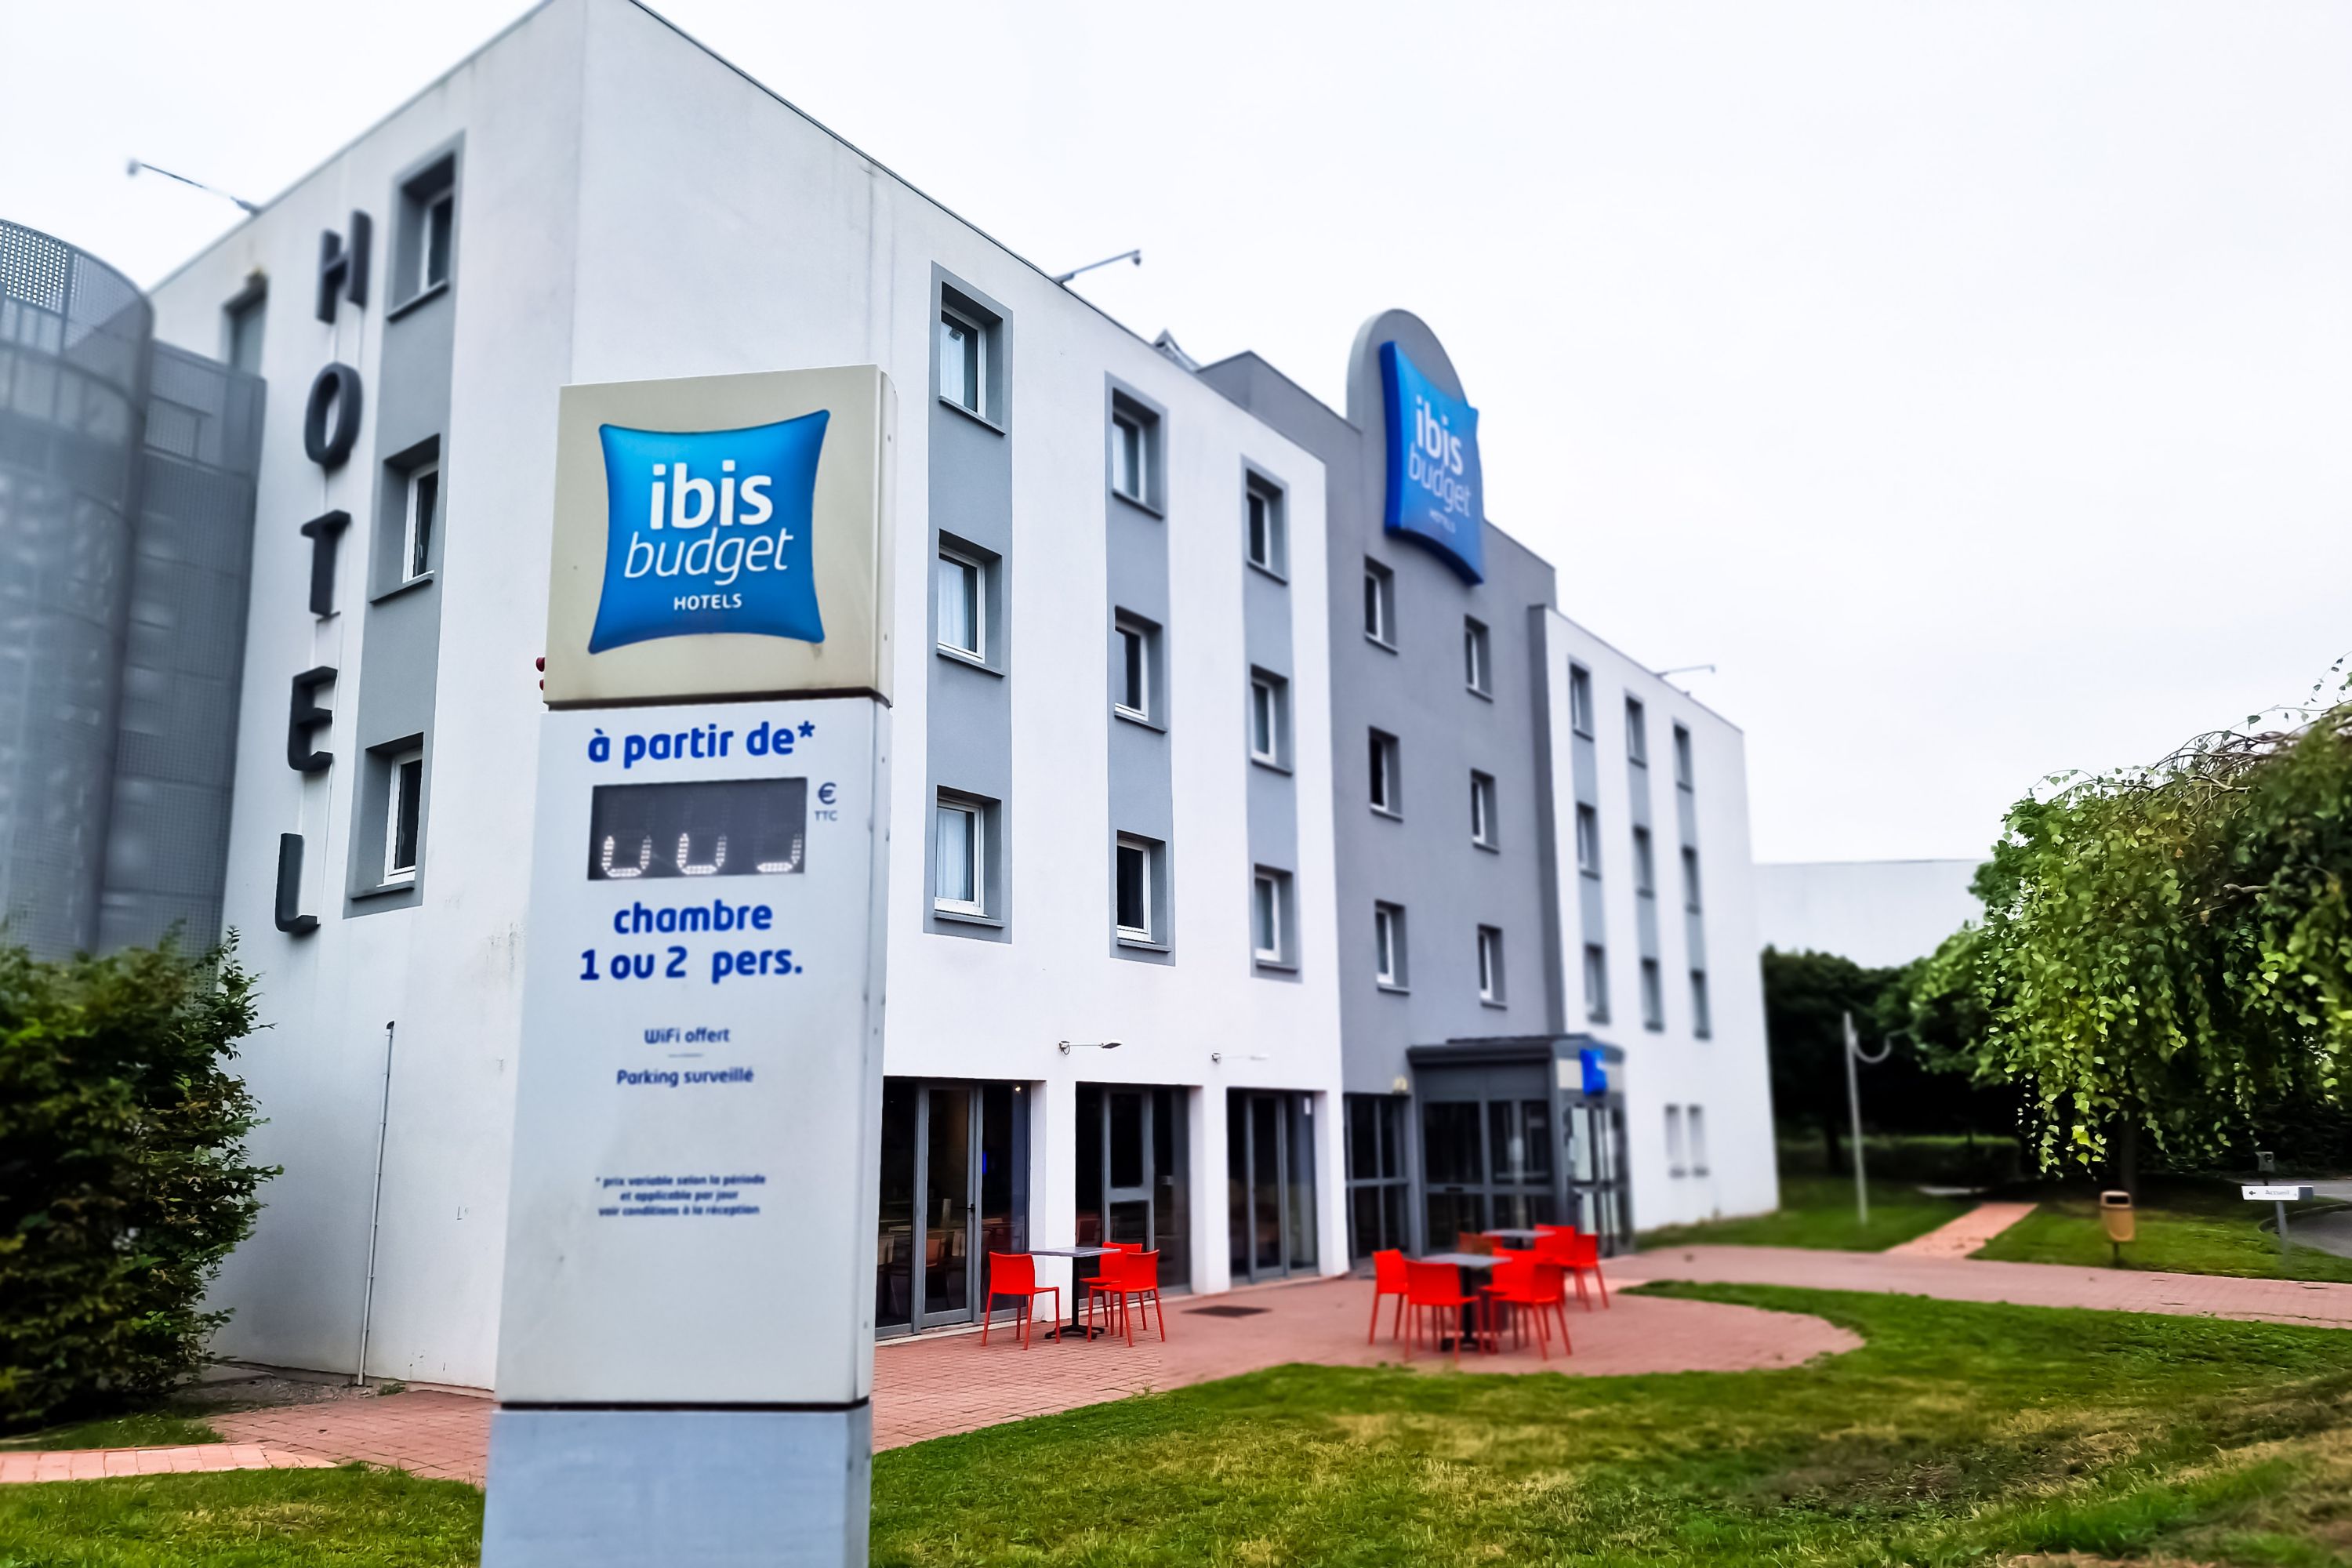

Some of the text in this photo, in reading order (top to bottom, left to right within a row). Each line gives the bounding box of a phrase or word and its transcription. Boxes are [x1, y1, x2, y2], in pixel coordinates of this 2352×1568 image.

[1415, 394, 1463, 476] ibis
[1408, 440, 1472, 518] budget
[650, 459, 773, 530] ibis
[276, 208, 372, 935] HOTEL
[624, 527, 793, 586] budget
[673, 593, 742, 611] HOTELS
[588, 728, 611, 762] à
[623, 723, 734, 769] partir
[817, 782, 837, 805] €
[815, 810, 838, 822] TTC
[614, 898, 773, 935] chambre
[580, 946, 803, 985] 1 ou 2 pers.
[644, 1027, 731, 1044] WiFi offert
[616, 1066, 754, 1087] Parking surveillé
[603, 1177, 625, 1188] prix
[628, 1174, 673, 1185] variable
[677, 1175, 706, 1185] selon
[710, 1174, 720, 1185] la
[723, 1174, 766, 1186] période
[620, 1190, 739, 1202] et applicable par jour
[598, 1207, 619, 1216] voir
[622, 1205, 680, 1216] conditions
[692, 1205, 702, 1215] la
[706, 1204, 760, 1217] réception
